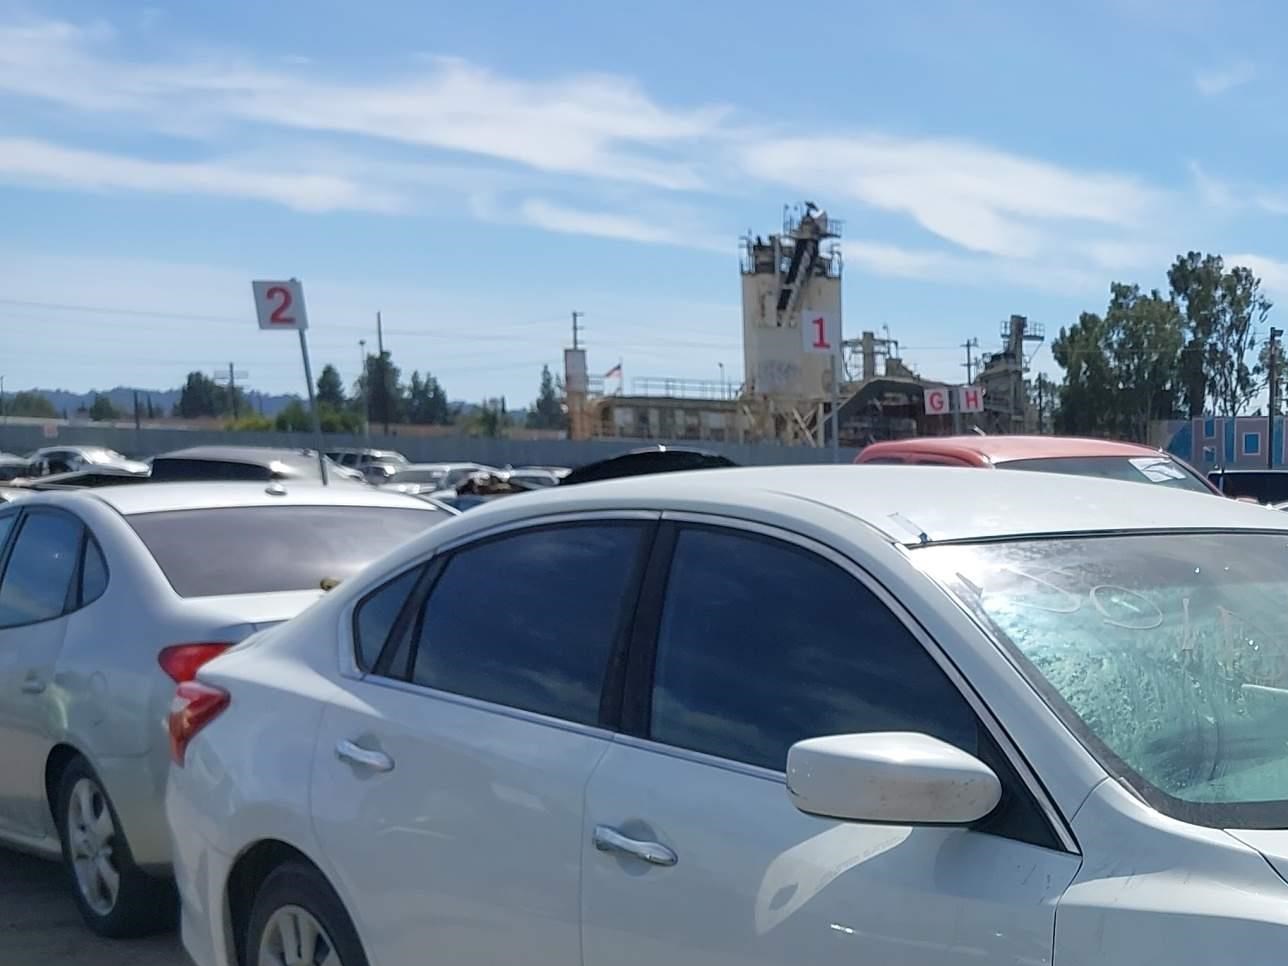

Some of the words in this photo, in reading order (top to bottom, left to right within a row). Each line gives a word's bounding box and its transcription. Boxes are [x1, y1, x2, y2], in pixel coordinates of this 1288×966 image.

[267, 287, 296, 325] 2
[812, 317, 831, 349] 1
[929, 391, 944, 411] G
[965, 390, 978, 409] H
